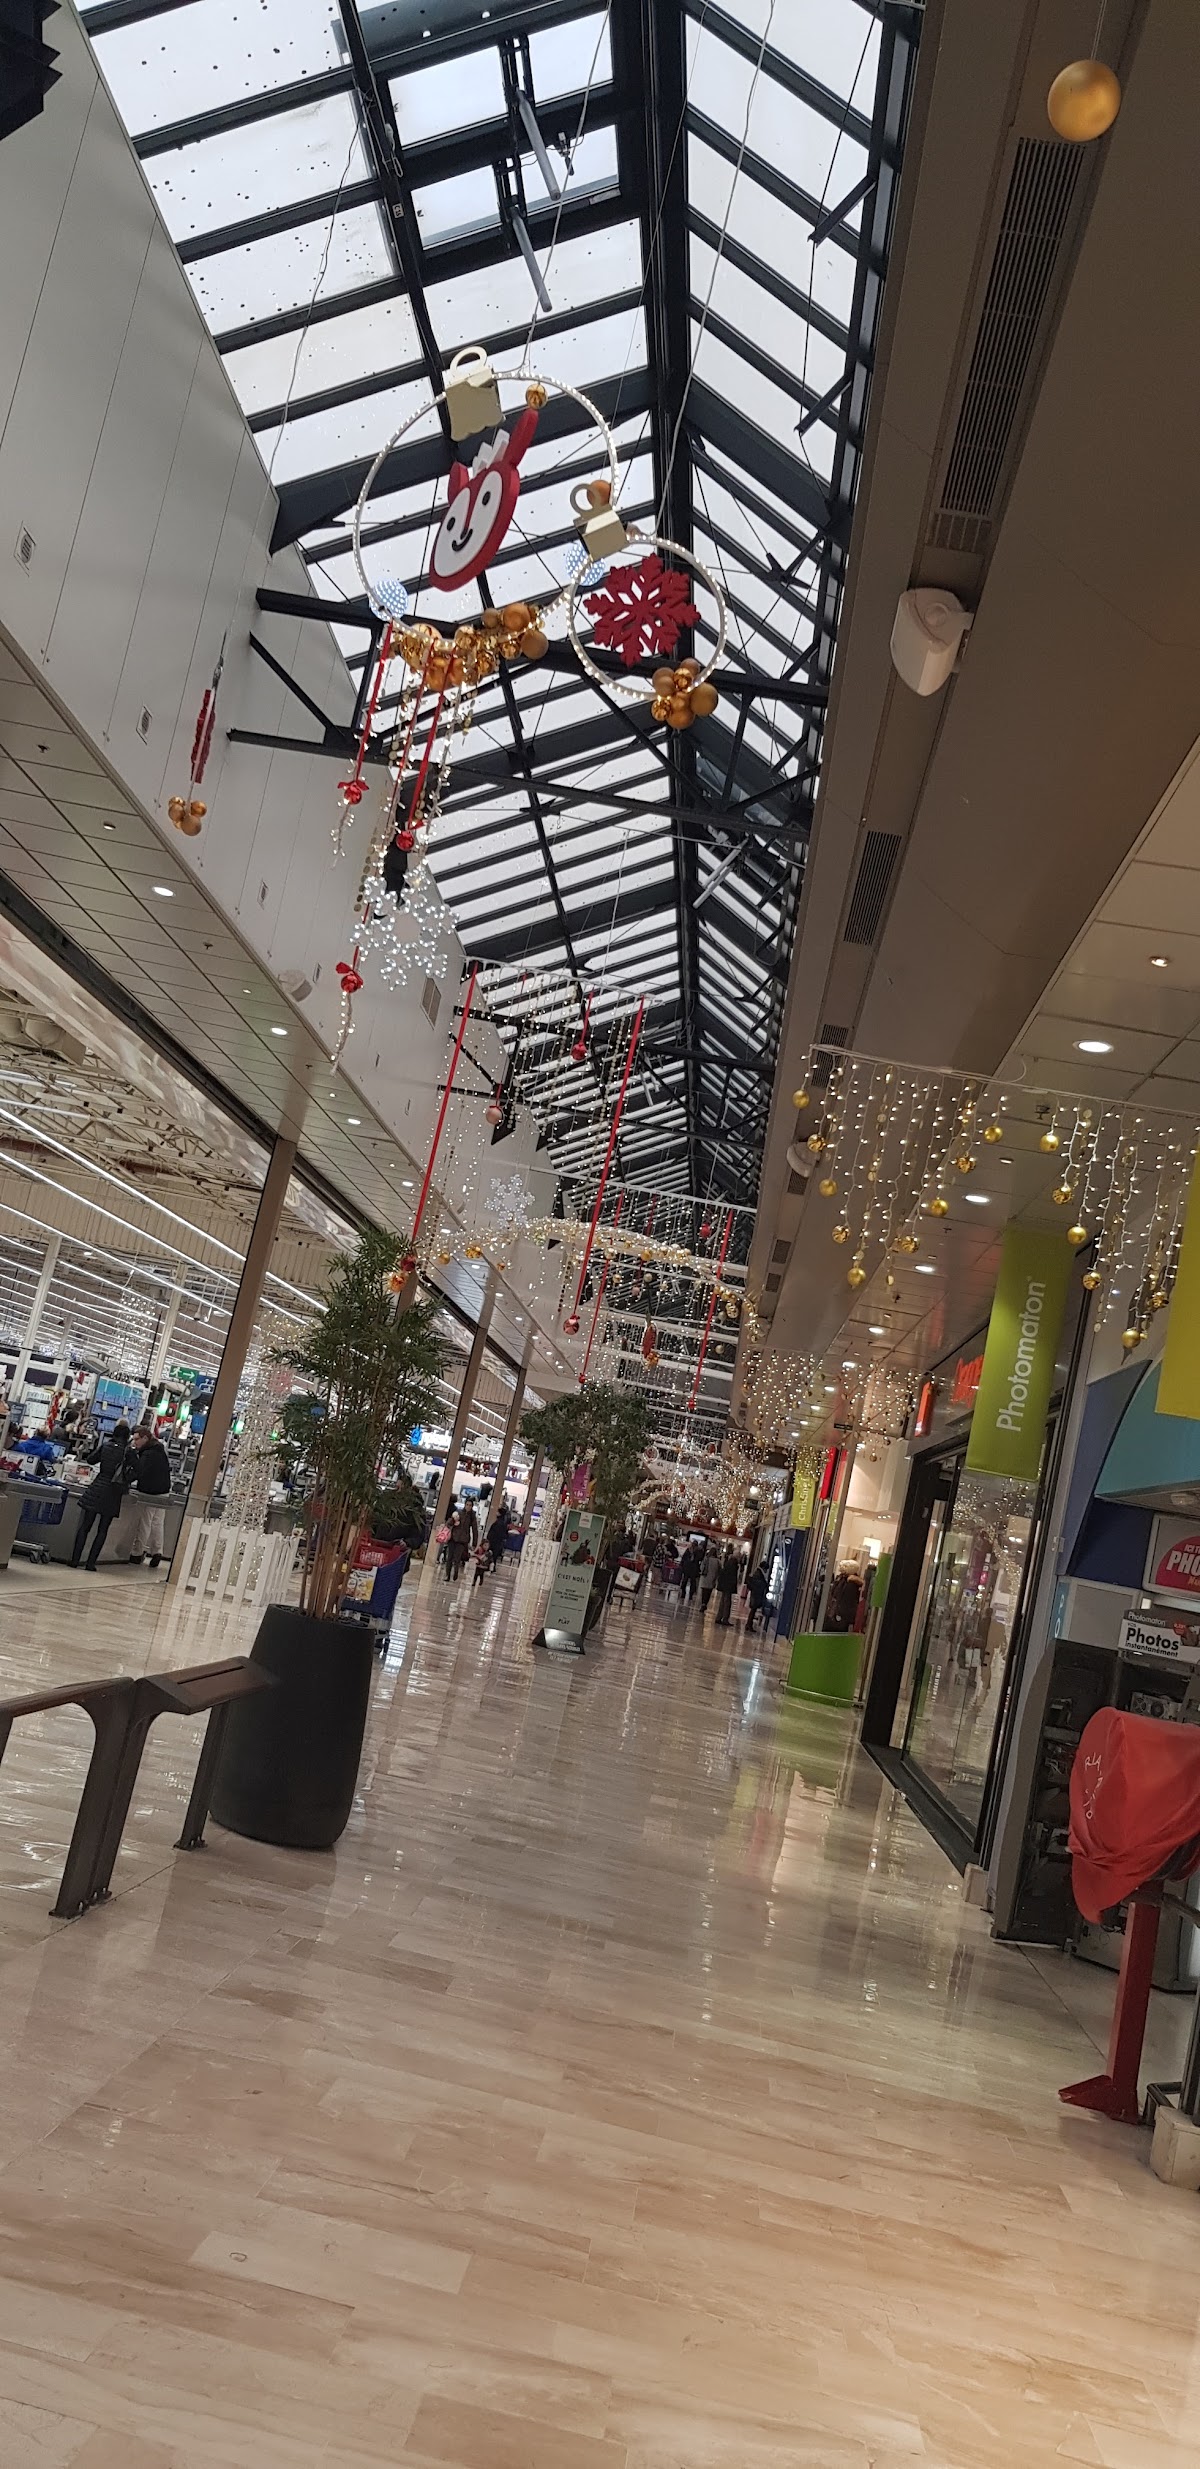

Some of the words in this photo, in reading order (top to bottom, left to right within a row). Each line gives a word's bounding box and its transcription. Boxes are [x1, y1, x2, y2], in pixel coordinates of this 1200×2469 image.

[996, 1281, 1046, 1432] Photomaton
[798, 1483, 810, 1521] Chrisine
[1128, 1611, 1166, 1627] Photomaton
[1126, 1627, 1179, 1650] Photos
